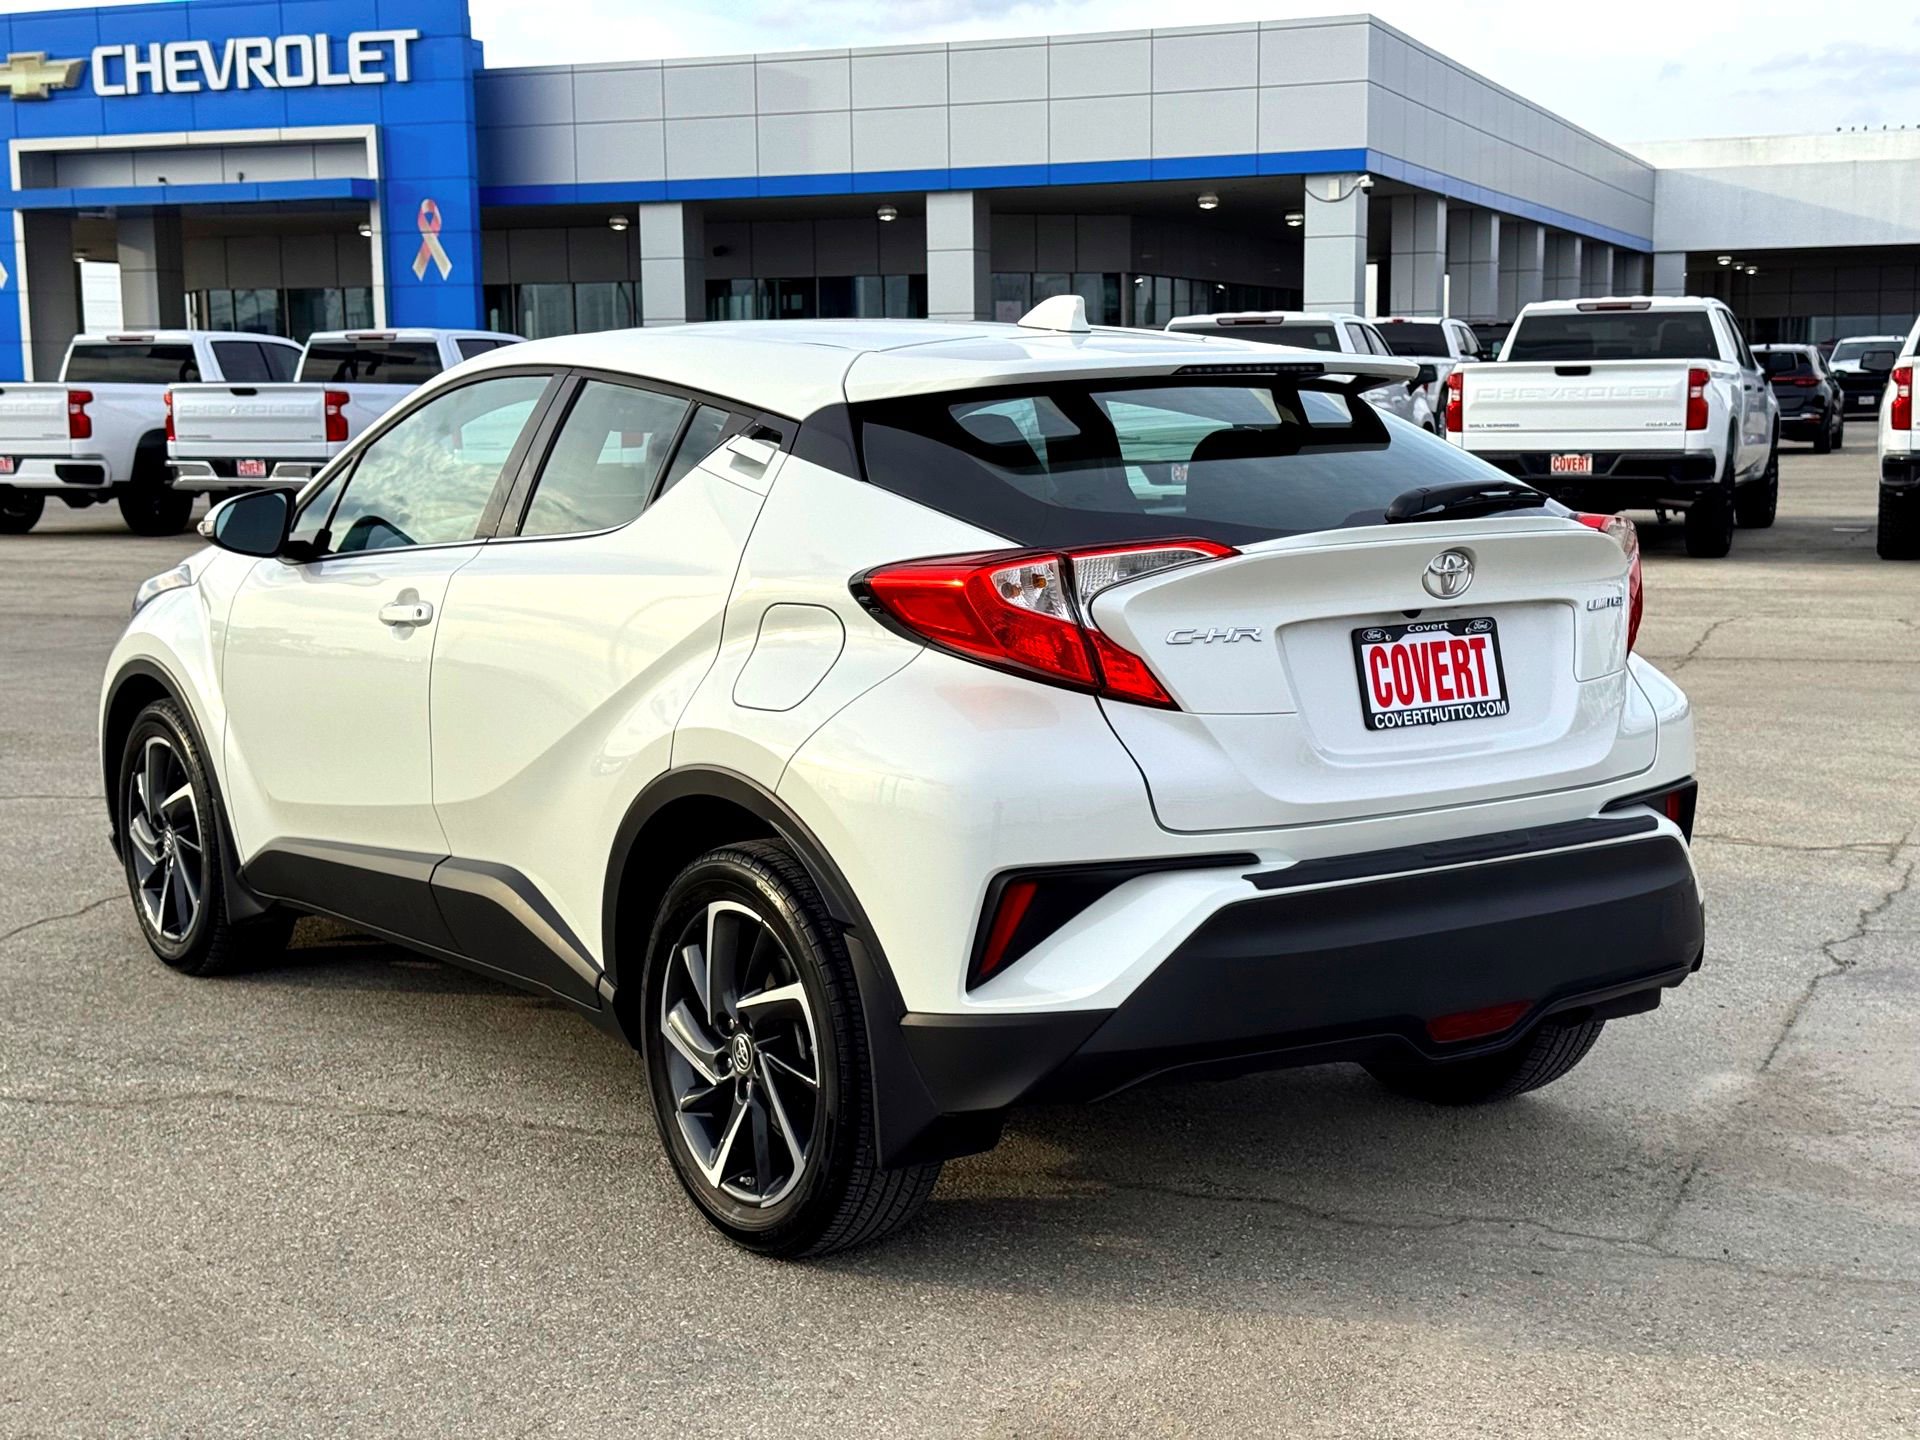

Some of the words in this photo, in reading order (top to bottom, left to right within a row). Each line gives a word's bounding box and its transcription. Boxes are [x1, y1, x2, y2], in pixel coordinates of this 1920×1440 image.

[92, 29, 419, 96] CHEVROLET
[1475, 386, 1673, 400] CHEVROLET
[1552, 455, 1590, 471] COVERT
[1165, 627, 1262, 645] C-HR
[1406, 621, 1450, 633] Covert
[1369, 637, 1490, 708] COVERT
[1374, 700, 1508, 729] COVERTHUTTO.COM
